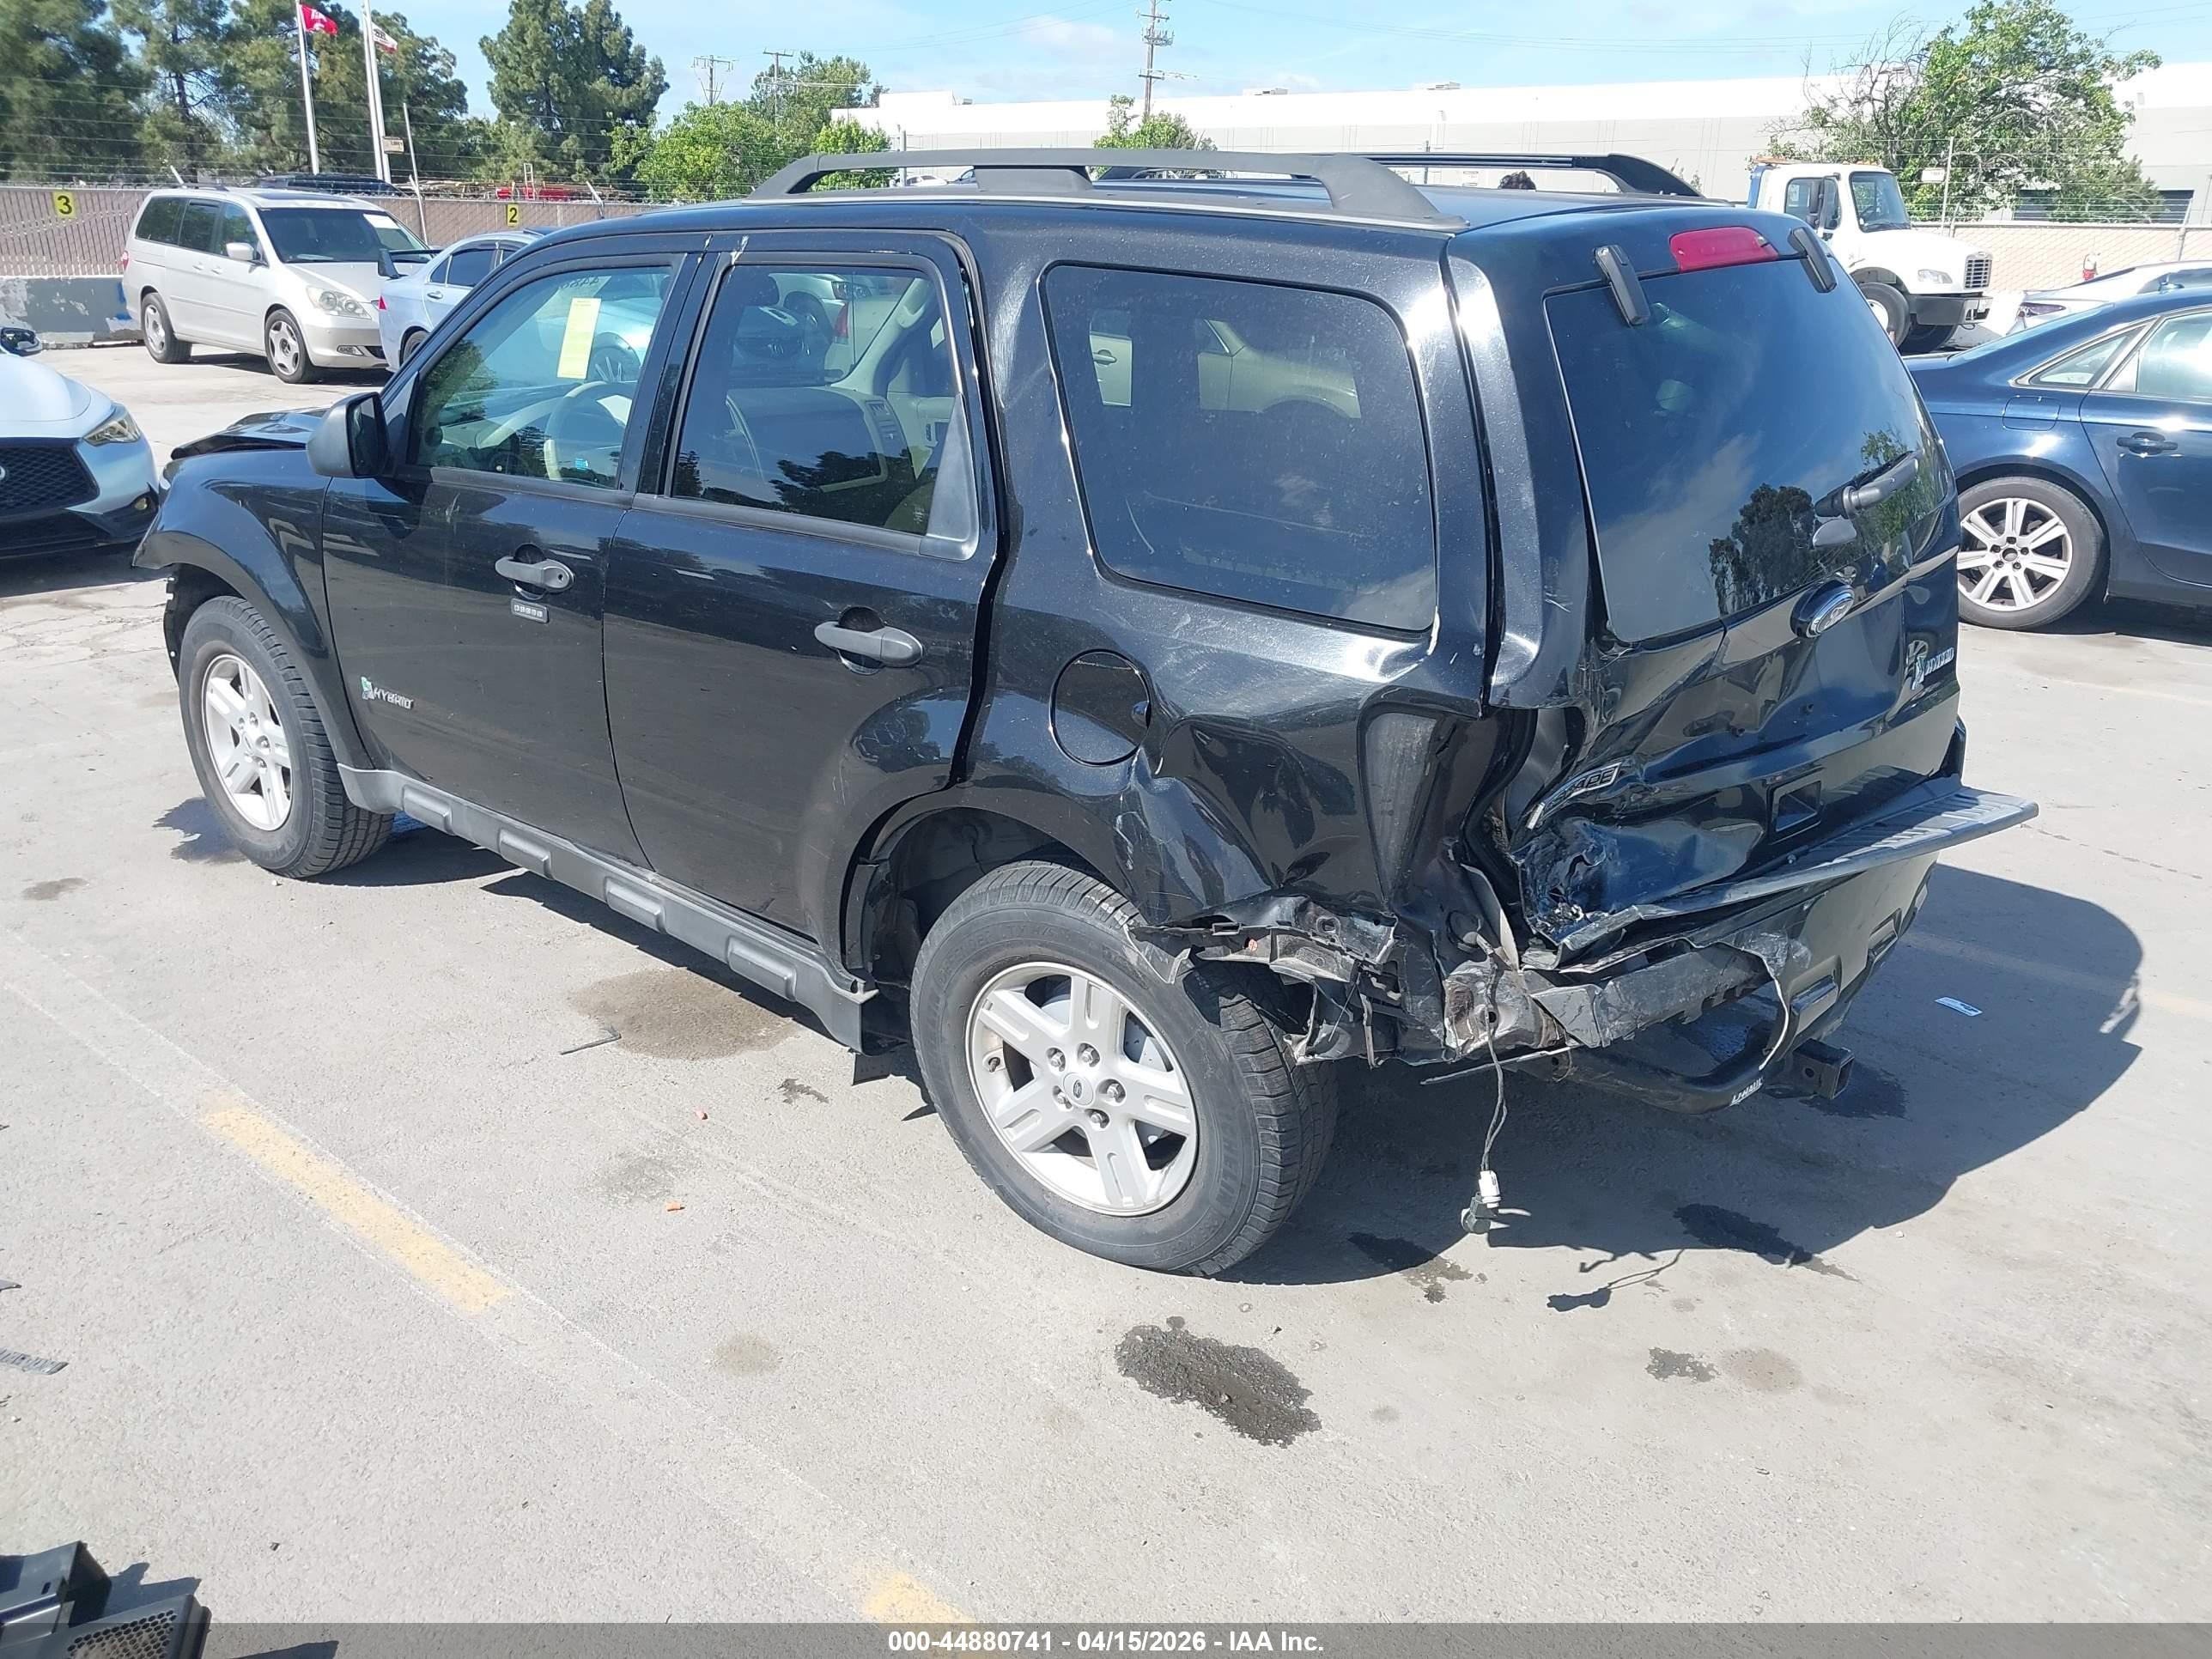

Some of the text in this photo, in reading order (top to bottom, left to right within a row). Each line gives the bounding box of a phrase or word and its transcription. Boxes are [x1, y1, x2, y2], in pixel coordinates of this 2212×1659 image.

[57, 195, 73, 215] 3
[509, 207, 518, 223] 2
[374, 687, 414, 709] HYBRID
